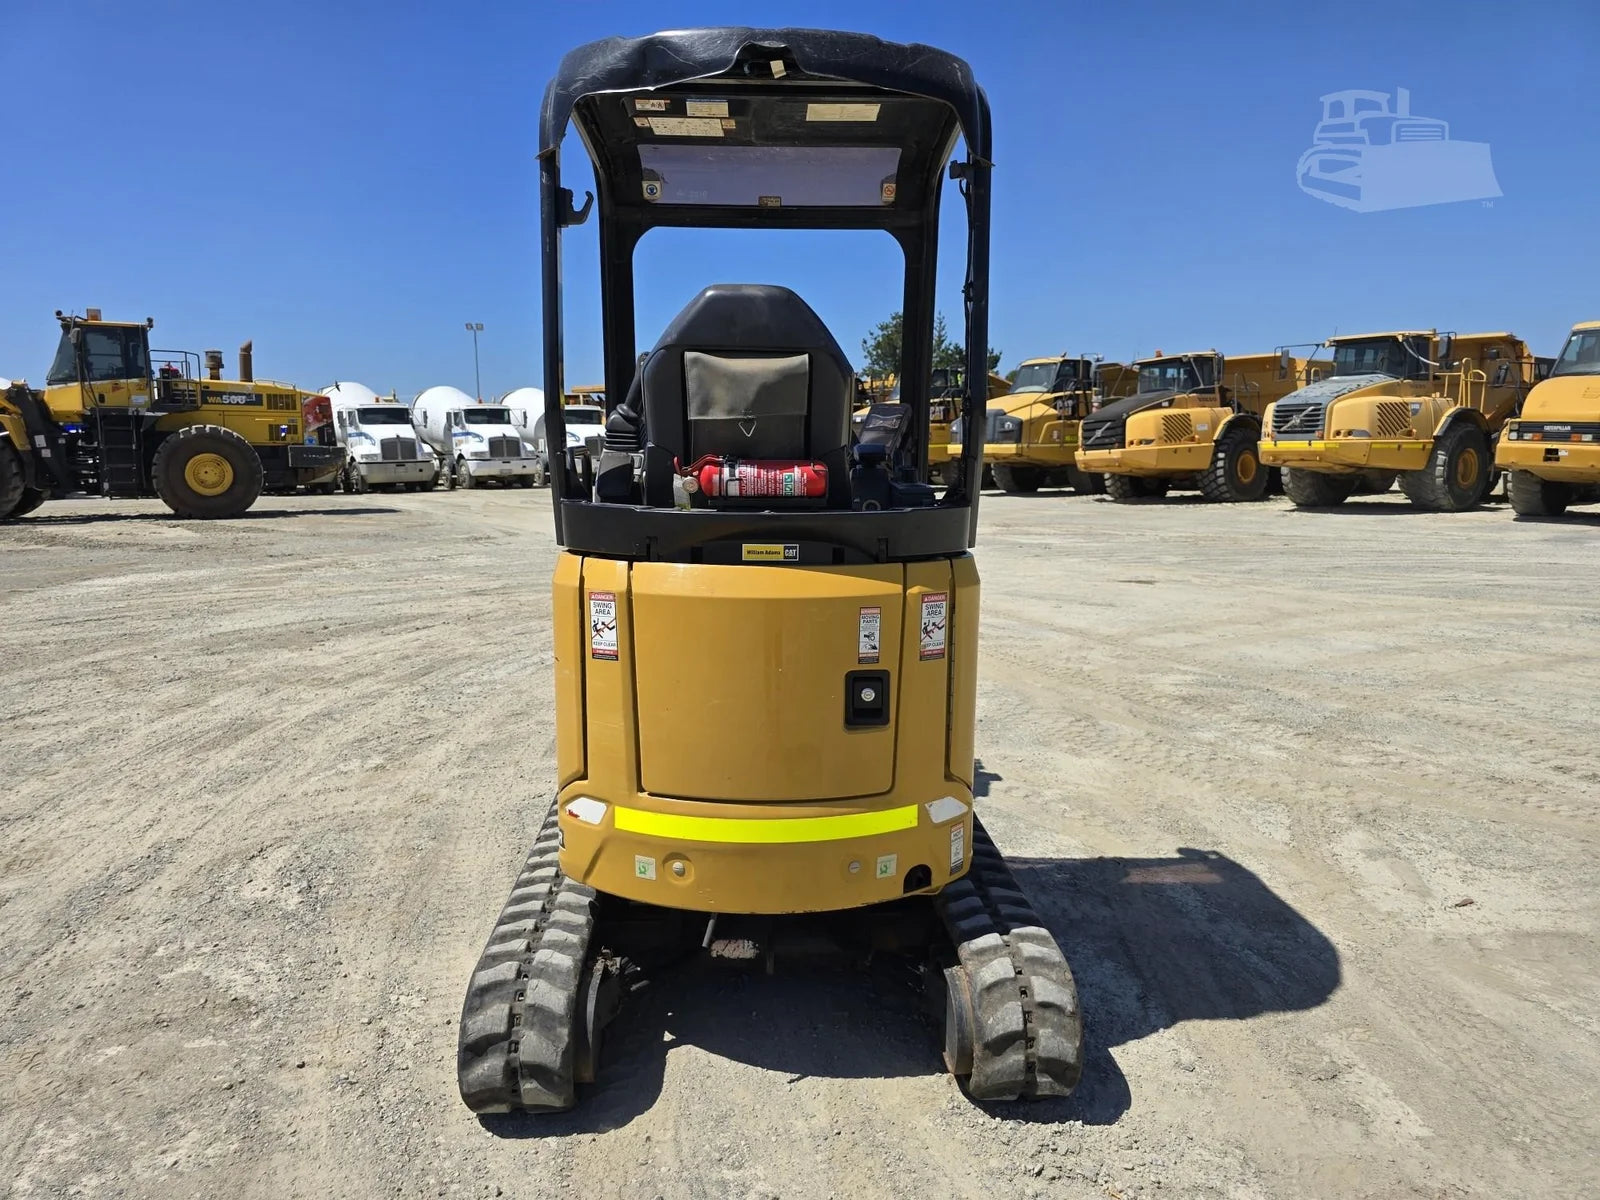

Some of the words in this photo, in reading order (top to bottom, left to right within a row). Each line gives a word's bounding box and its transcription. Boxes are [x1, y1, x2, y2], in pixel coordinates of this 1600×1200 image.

[593, 601, 612, 609] SWING
[925, 602, 944, 610] SWING
[595, 608, 611, 616] AREA
[927, 609, 942, 617] AREA
